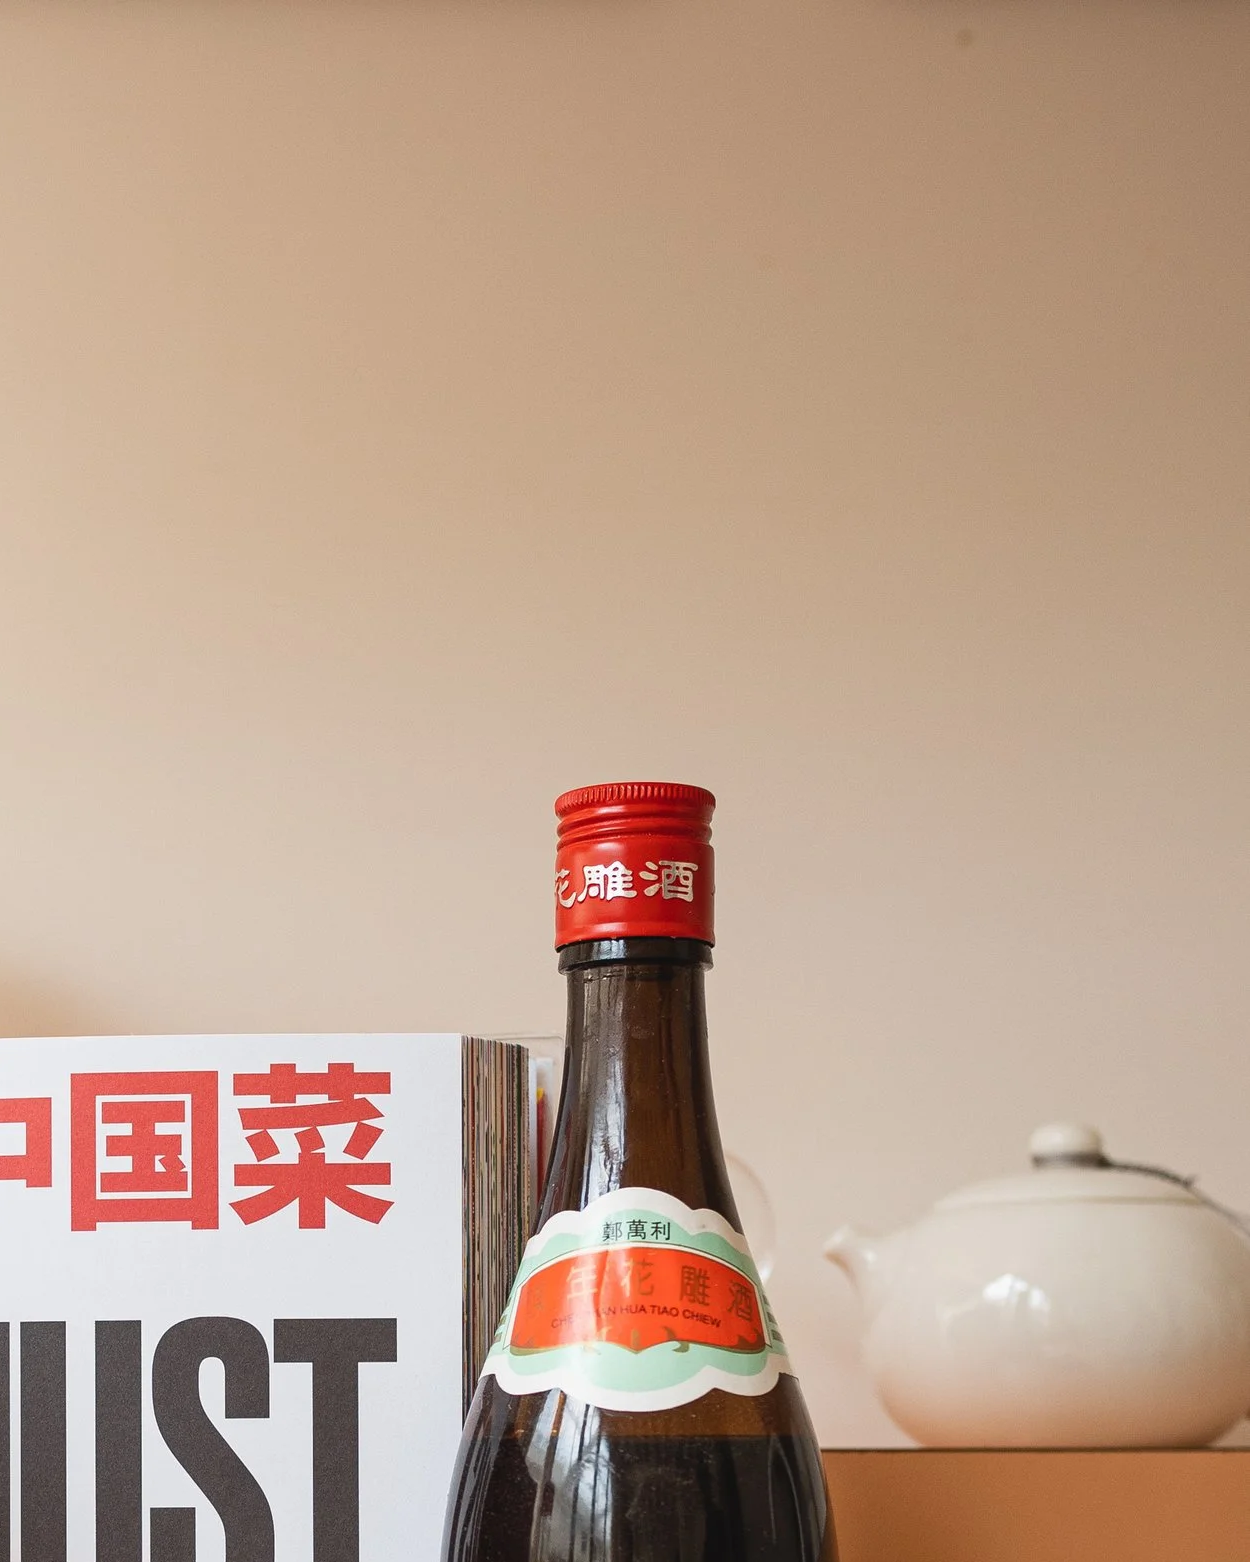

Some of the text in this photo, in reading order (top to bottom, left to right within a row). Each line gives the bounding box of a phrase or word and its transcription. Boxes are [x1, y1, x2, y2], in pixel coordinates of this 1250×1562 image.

[602, 1218, 672, 1242] 鄭萬利
[620, 1304, 648, 1315] HUA
[650, 1305, 680, 1318] TIAO
[682, 1308, 722, 1329] CHIEW
